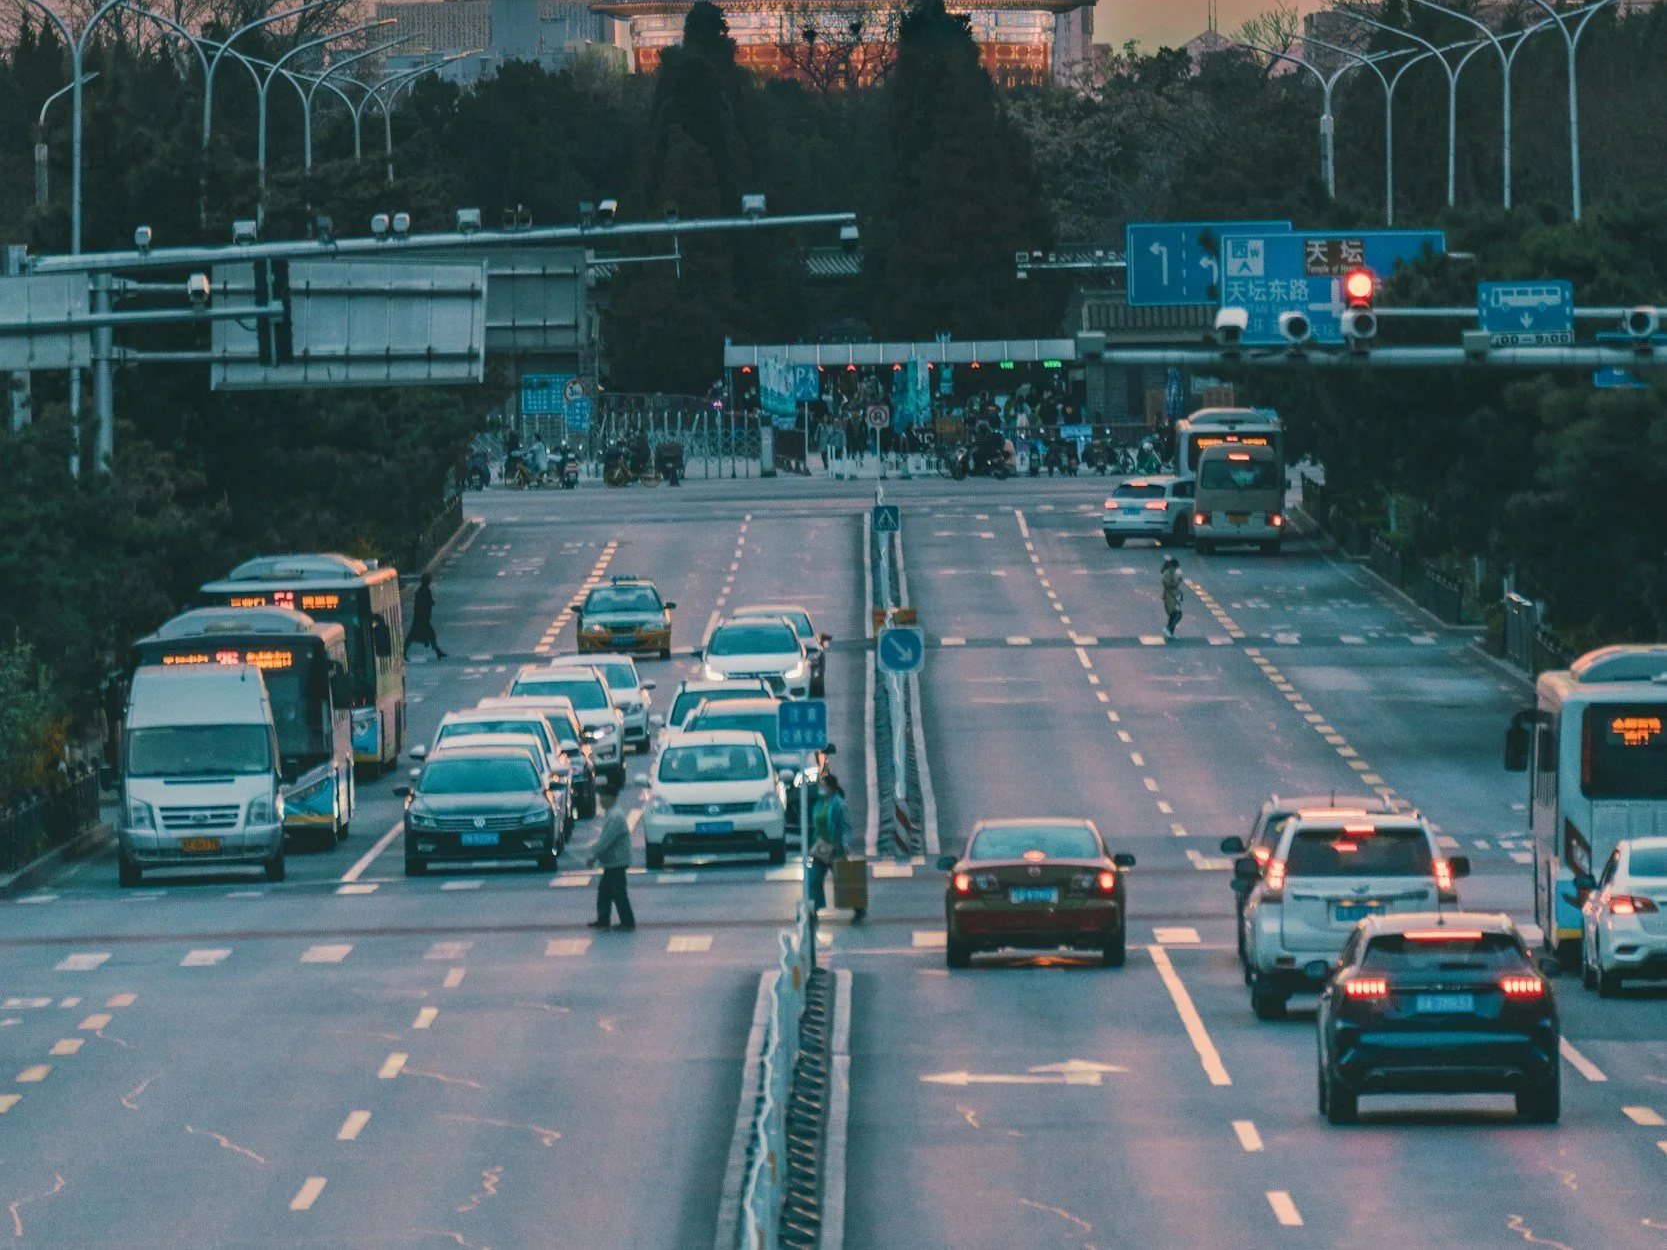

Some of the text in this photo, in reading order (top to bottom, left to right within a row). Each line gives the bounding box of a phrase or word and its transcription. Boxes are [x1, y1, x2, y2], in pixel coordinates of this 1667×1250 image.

[1306, 240, 1362, 263] 天坛
[1227, 279, 1309, 302] 天坛东路
[796, 367, 805, 379] P
